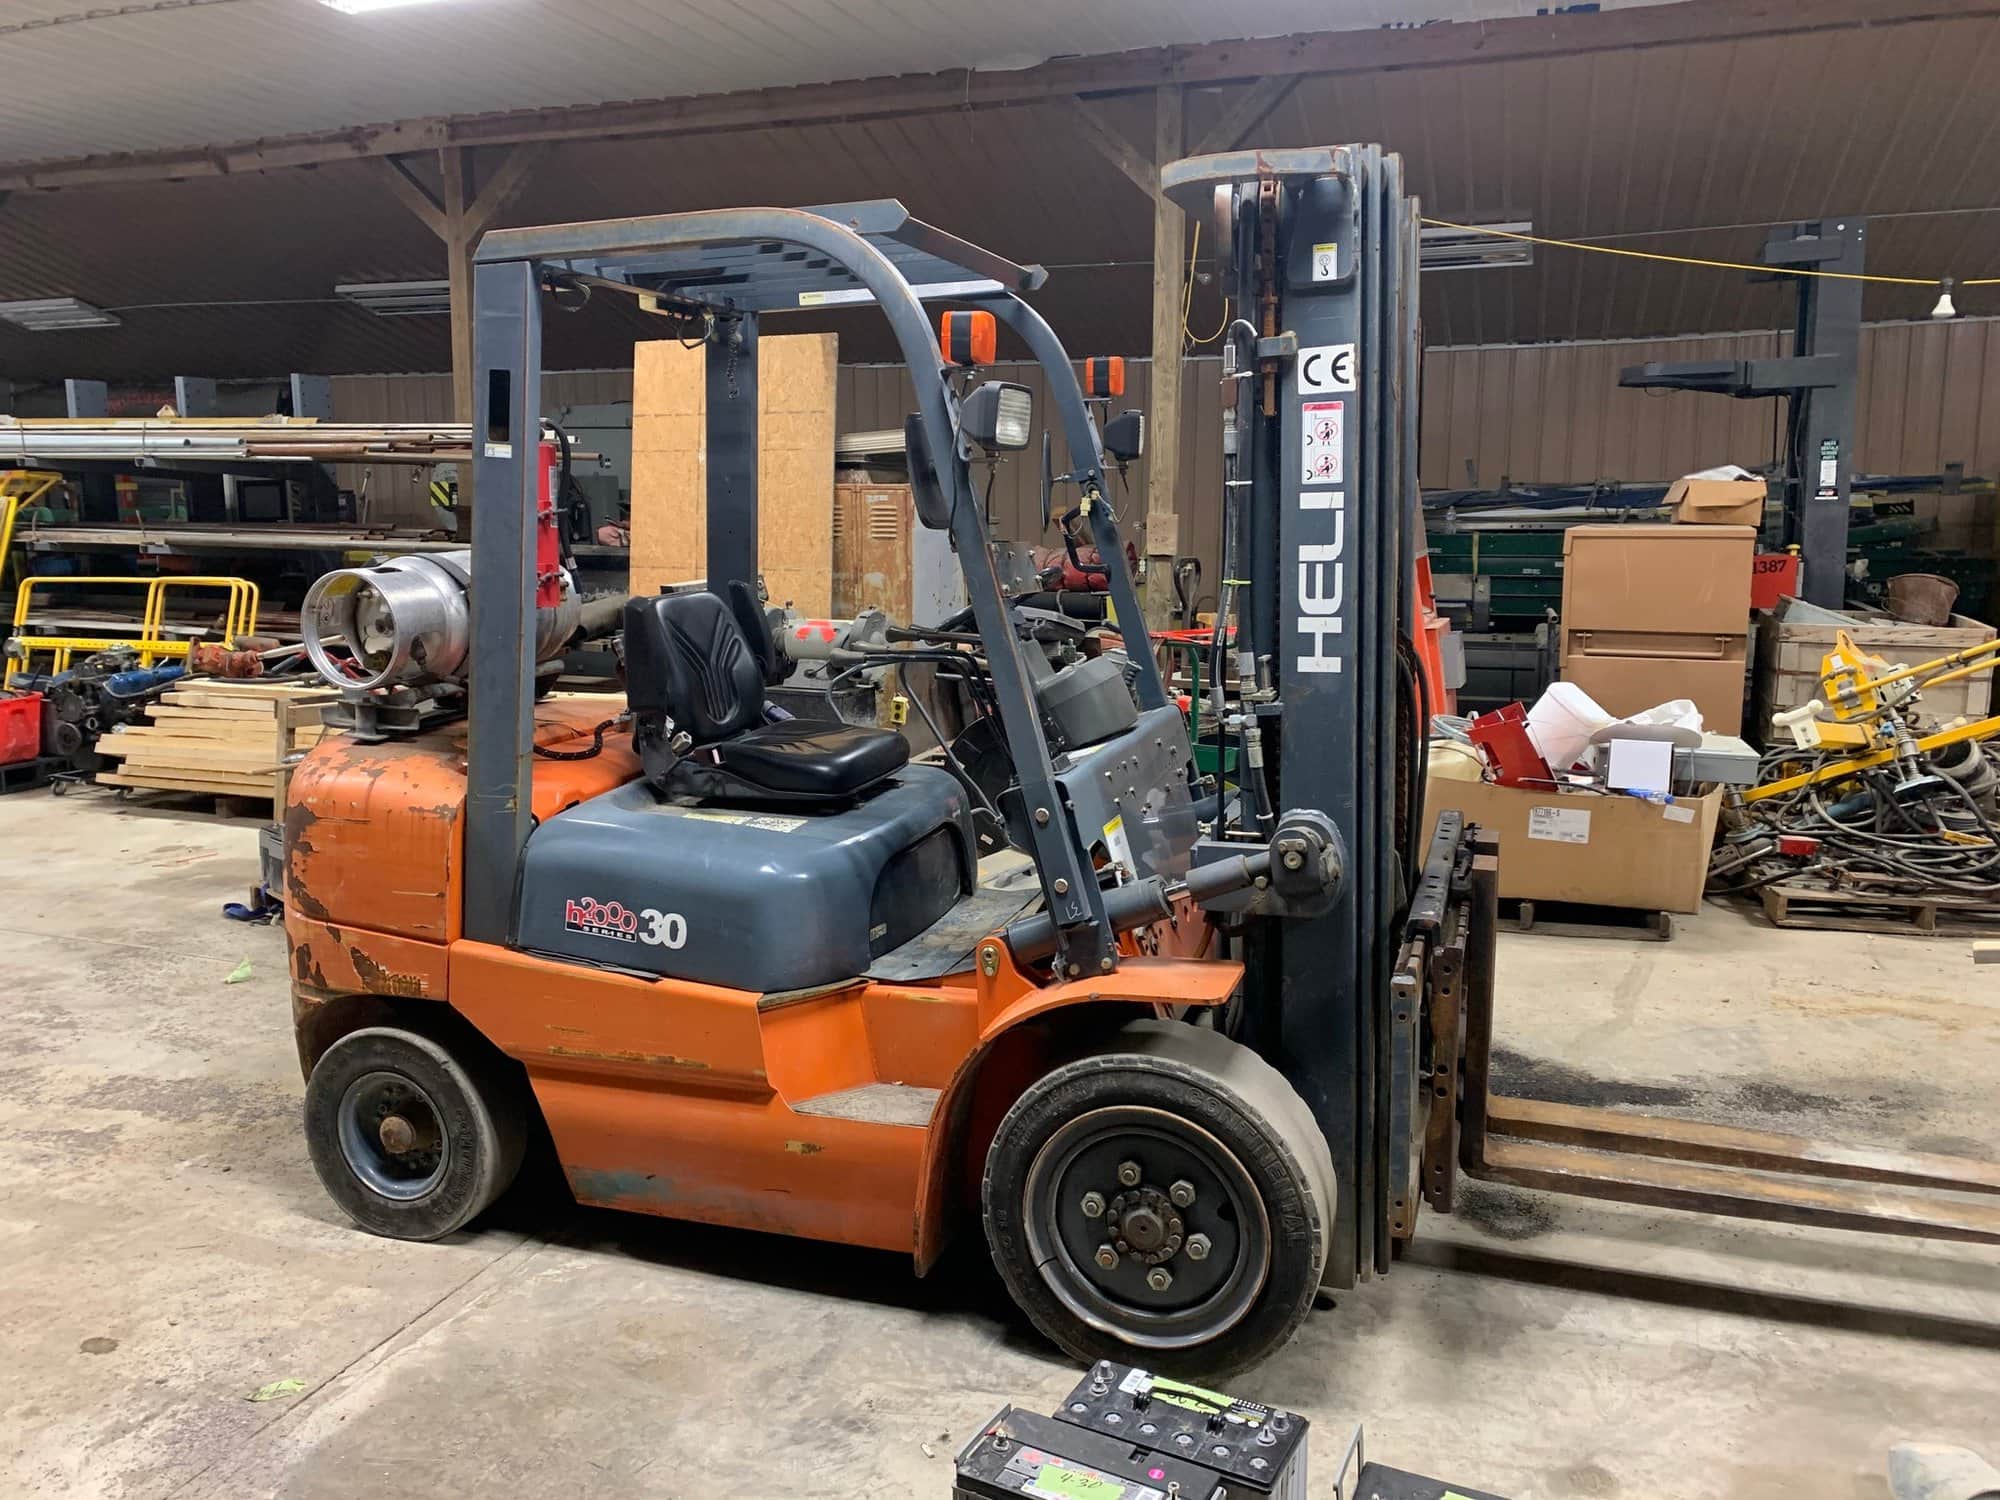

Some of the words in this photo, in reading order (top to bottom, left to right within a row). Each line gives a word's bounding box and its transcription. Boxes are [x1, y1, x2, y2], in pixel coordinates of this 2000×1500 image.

[1303, 351, 1350, 387] CE
[1297, 491, 1345, 673] HELI
[583, 924, 633, 940] SERIES
[639, 908, 687, 949] 30
